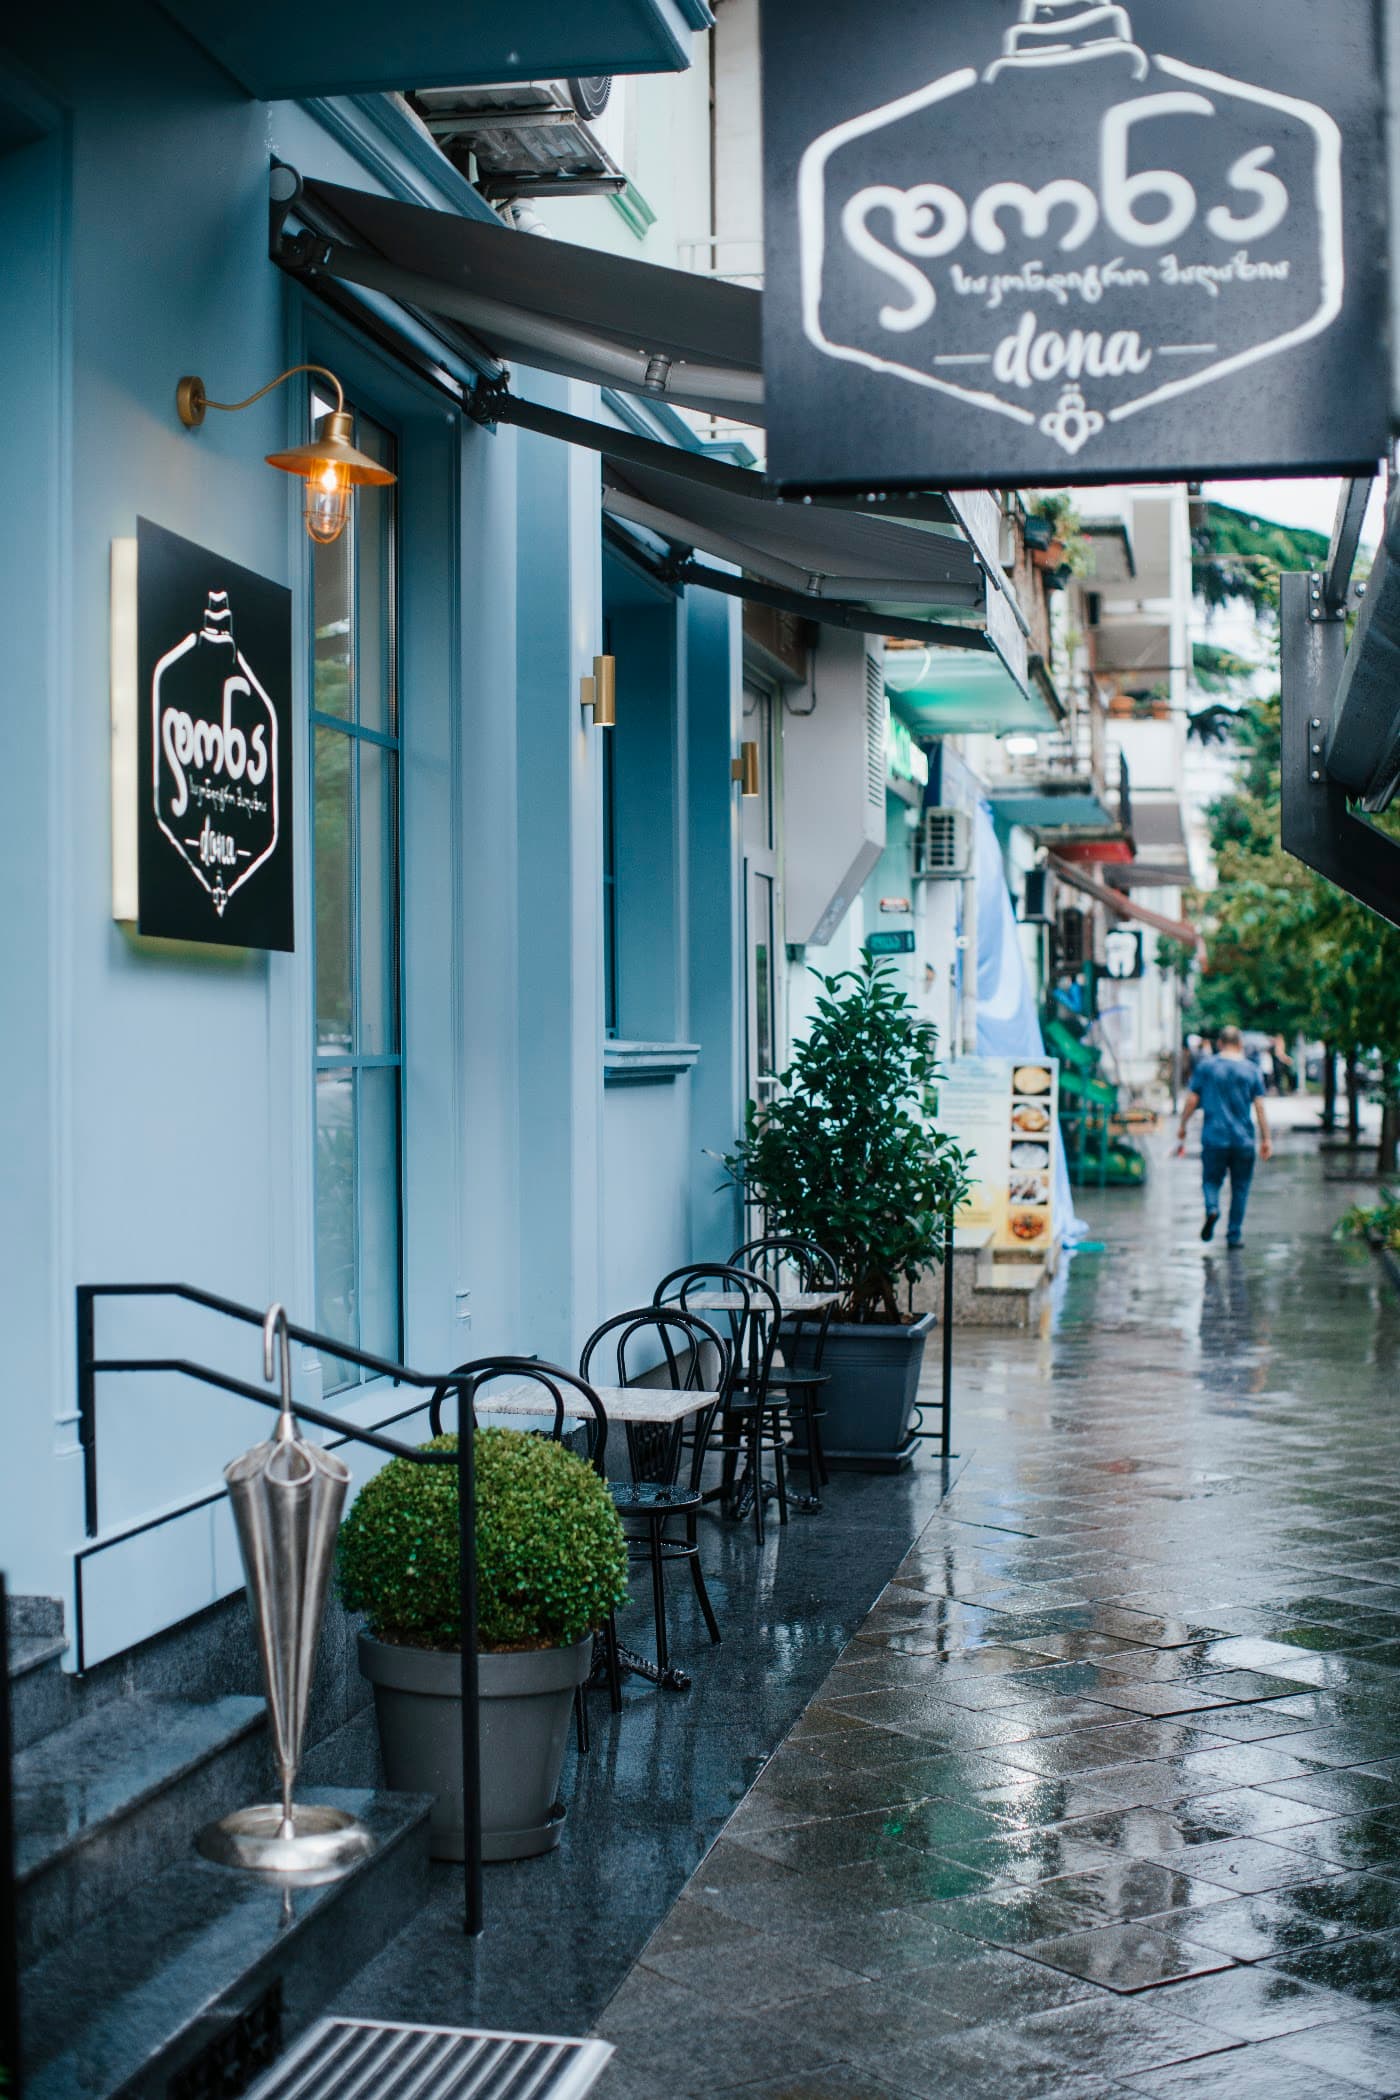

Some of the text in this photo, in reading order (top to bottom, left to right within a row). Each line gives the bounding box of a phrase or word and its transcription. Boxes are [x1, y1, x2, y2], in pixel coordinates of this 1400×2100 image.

[842, 91, 1288, 331] დონა
[993, 311, 1150, 388] dona
[162, 676, 267, 817] დონა
[200, 814, 236, 866] dona
